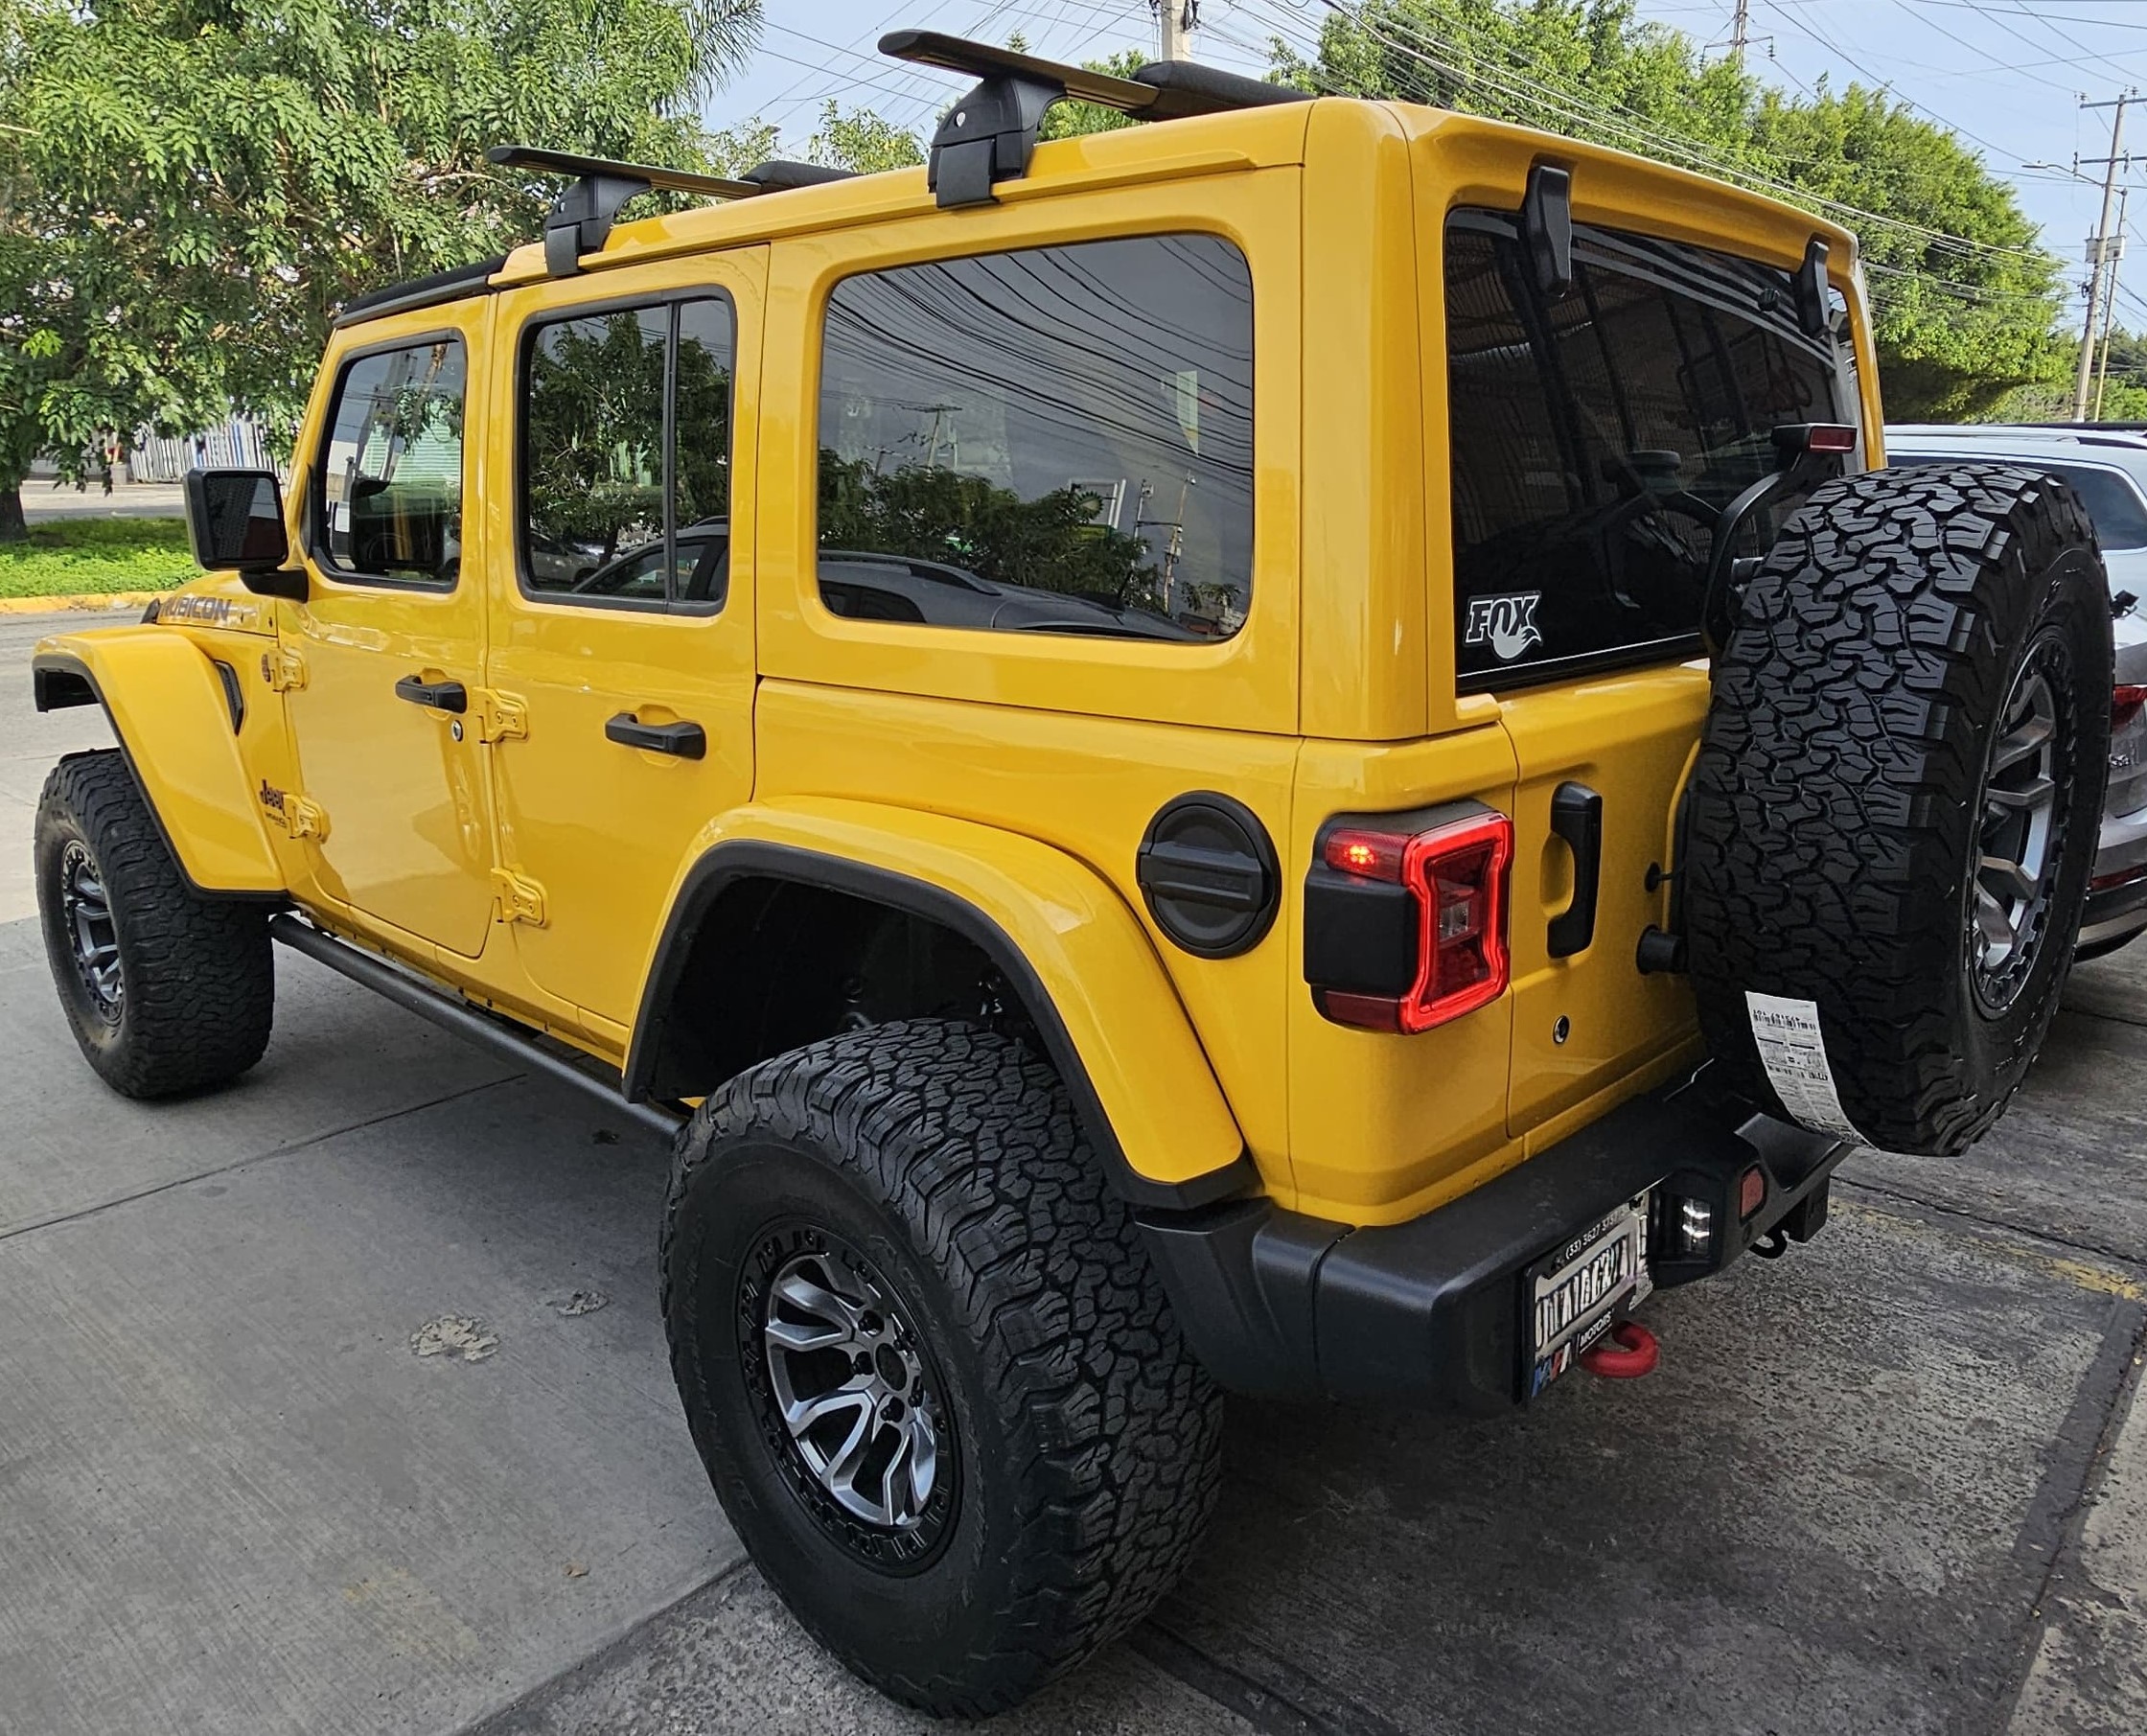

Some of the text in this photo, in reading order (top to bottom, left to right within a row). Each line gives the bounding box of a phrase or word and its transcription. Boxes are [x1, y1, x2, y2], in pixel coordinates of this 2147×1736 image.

[160, 596, 232, 621] RUBICON
[1466, 594, 1540, 643] FOX
[1580, 1310, 1611, 1348] MOTORS
